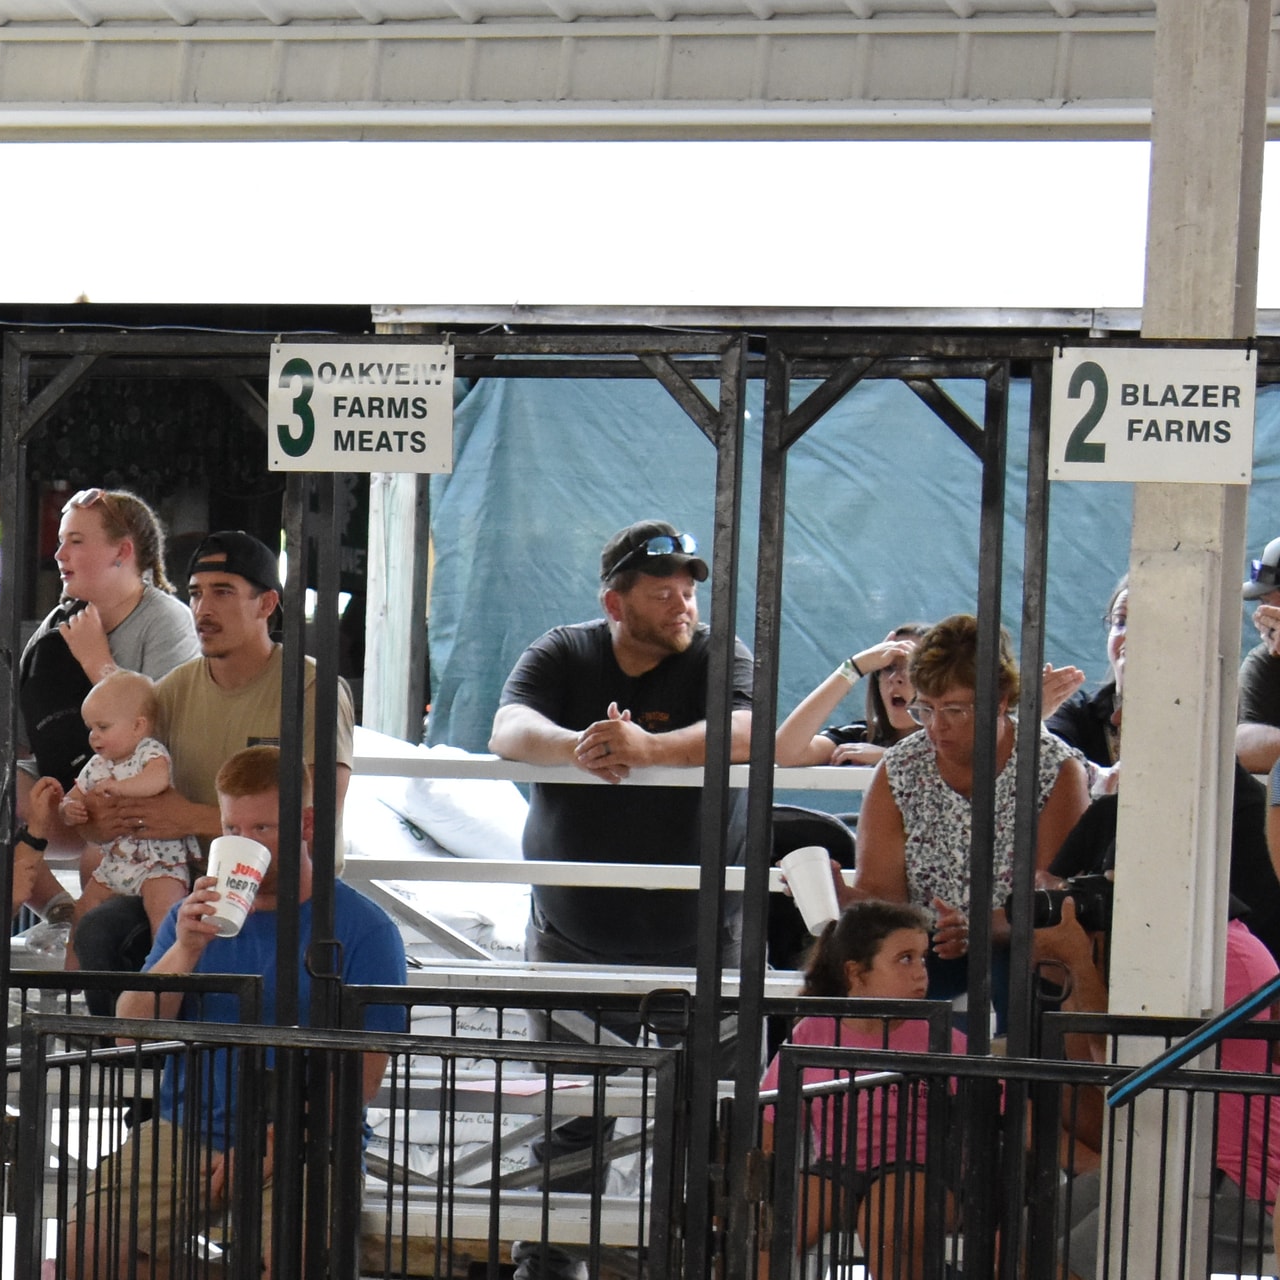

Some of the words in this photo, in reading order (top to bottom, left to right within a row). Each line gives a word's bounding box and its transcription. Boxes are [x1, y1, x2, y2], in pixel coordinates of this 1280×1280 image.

[318, 362, 446, 385] OAKVEIW
[1121, 384, 1240, 407] BLAZER
[277, 358, 315, 457] 3
[334, 397, 427, 419] FARMS
[1064, 361, 1108, 463] 2
[334, 430, 426, 453] MEATS
[1128, 419, 1231, 443] FARMS
[226, 876, 248, 891] ICED
[456, 1020, 493, 1033] Wonder
[476, 1114, 509, 1127] Crub
